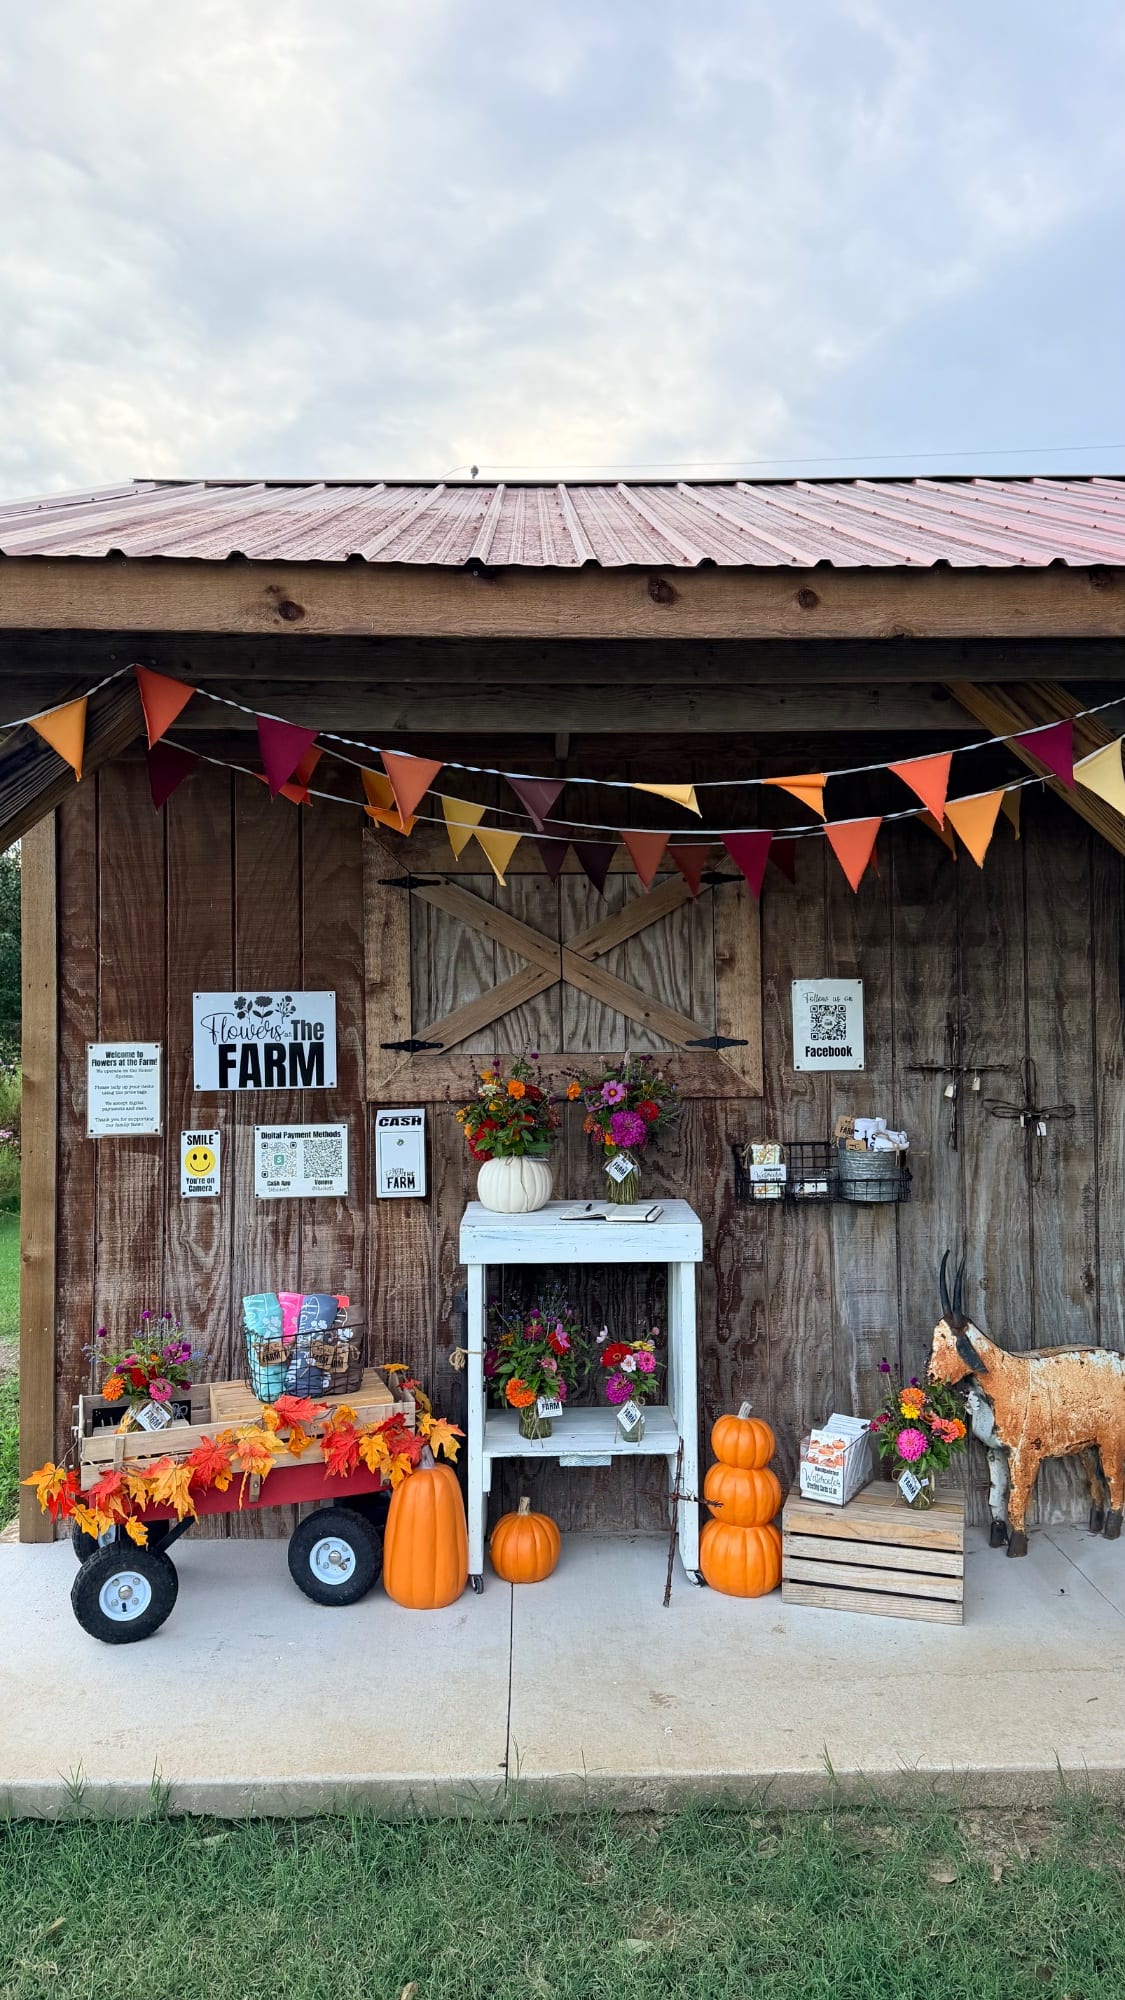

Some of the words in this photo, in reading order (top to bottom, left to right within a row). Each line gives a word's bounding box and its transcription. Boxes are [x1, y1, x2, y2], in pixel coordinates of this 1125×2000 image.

[803, 992, 829, 1003] Follow
[200, 1012, 285, 1045] Flowers
[291, 1019, 324, 1041] The
[805, 1046, 852, 1057] Facebook
[91, 1059, 117, 1067] Flowers
[118, 1059, 125, 1067] at
[126, 1058, 138, 1066] the
[138, 1058, 158, 1066] Farm!
[218, 1042, 325, 1088] FARM
[378, 1117, 422, 1127] CASH
[186, 1134, 214, 1146] SMILE
[260, 1131, 283, 1140] Digital
[283, 1131, 312, 1140] Payment
[312, 1130, 342, 1138] Methods
[612, 1161, 628, 1177] FARM
[387, 1176, 416, 1190] FARM
[541, 1401, 561, 1411] FARM
[143, 1410, 162, 1429] FARM
[623, 1408, 636, 1426] FARM
[903, 1477, 916, 1496] FARM
